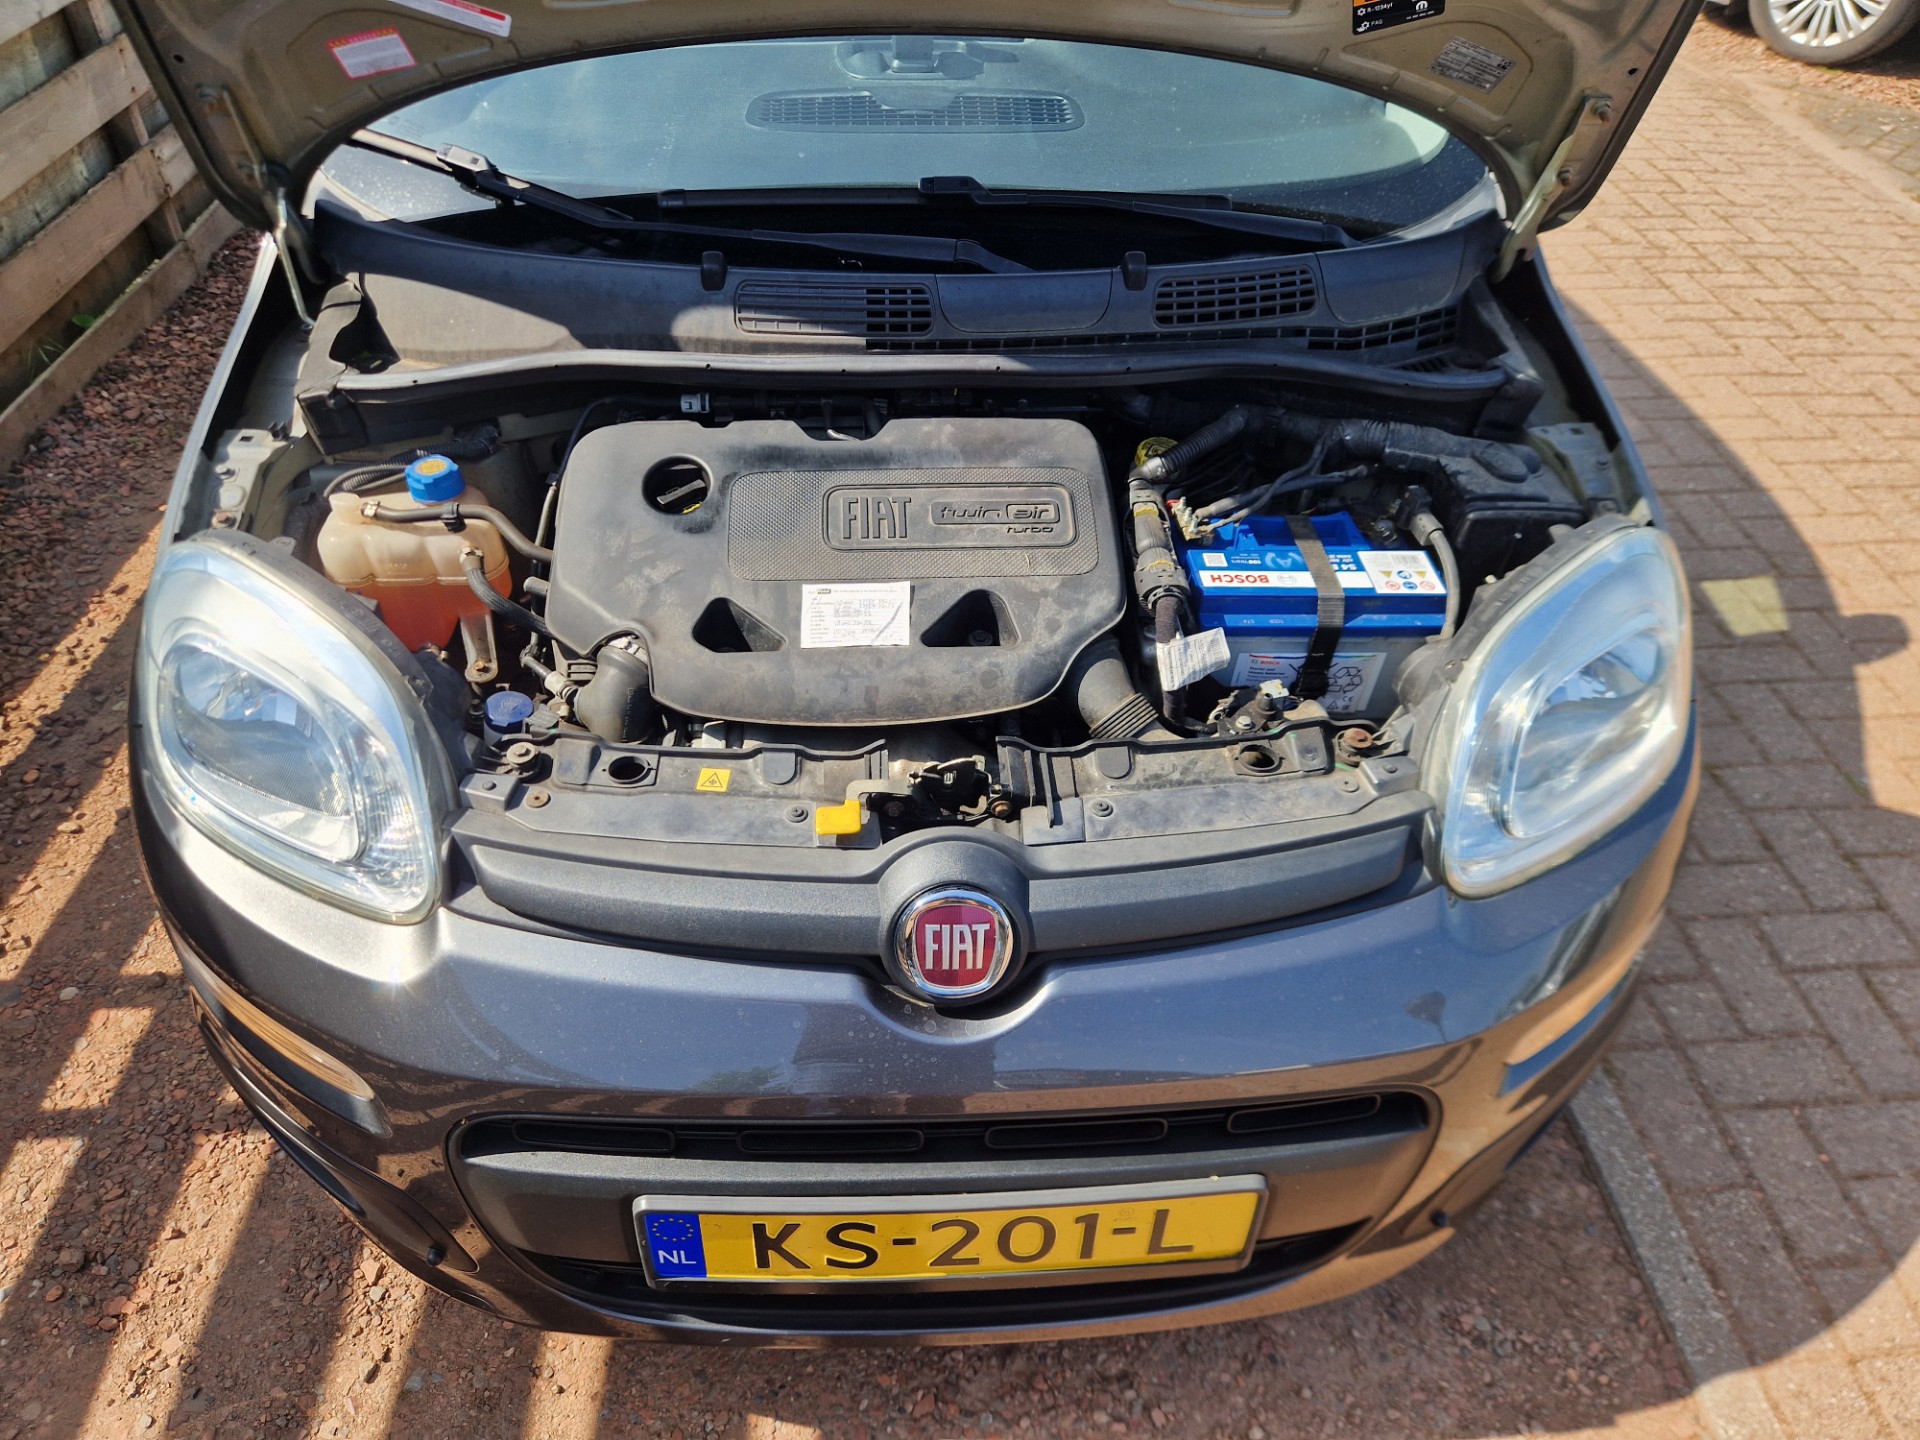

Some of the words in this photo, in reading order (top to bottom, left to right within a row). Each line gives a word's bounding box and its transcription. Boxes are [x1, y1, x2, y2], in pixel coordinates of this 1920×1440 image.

[842, 496, 911, 540] FIAT
[941, 505, 1001, 519] twin
[1014, 505, 1051, 520] air
[1005, 525, 1054, 534] turbo
[1210, 574, 1269, 584] BOSCH
[924, 923, 991, 970] FIAT
[752, 1208, 1194, 1270] KS-201-L
[659, 1249, 697, 1265] NL
